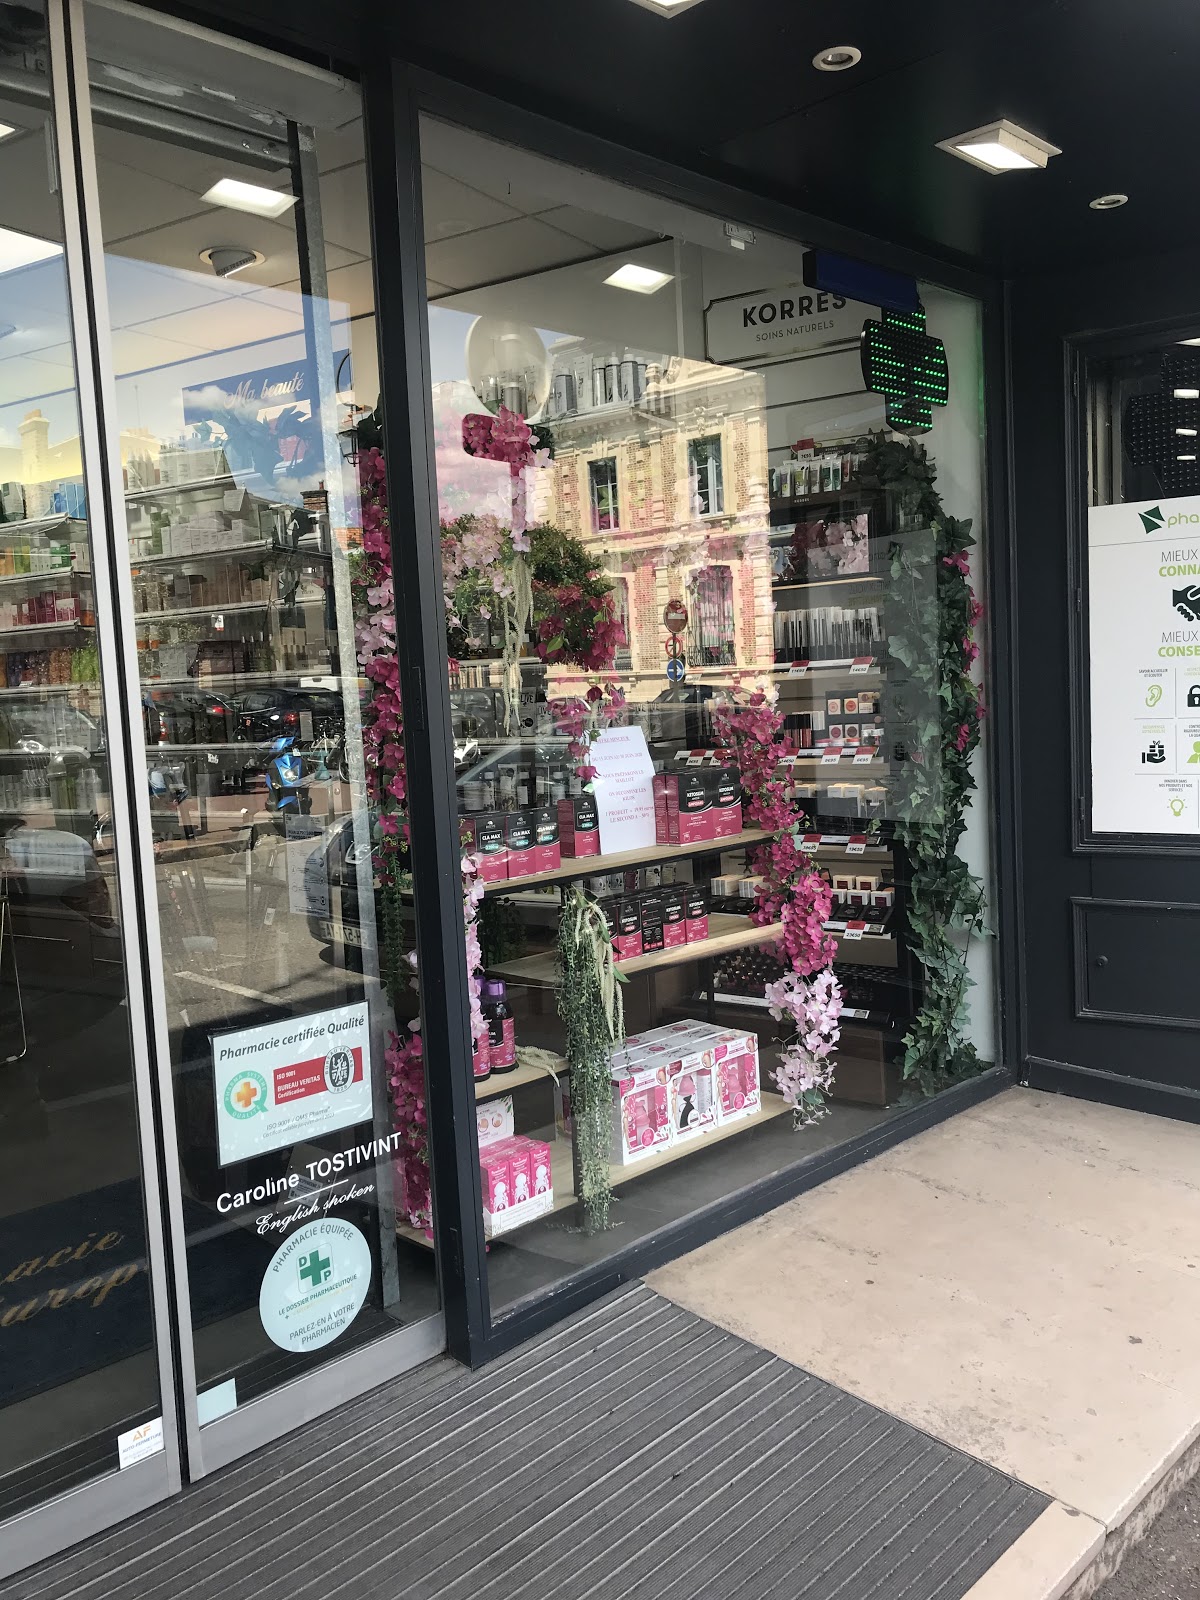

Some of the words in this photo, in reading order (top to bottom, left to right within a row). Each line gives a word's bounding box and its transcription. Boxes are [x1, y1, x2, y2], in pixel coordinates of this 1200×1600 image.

[743, 292, 847, 328] KORRES
[756, 330, 784, 342] SOINS
[786, 320, 834, 337] NATURELS
[224, 379, 256, 409] Ma
[260, 371, 305, 399] beauté
[1167, 512, 1200, 529] pha
[1161, 549, 1199, 562] MIEUX
[1161, 630, 1199, 643] MIEUX
[220, 1038, 280, 1061] Pharmacie
[282, 1026, 325, 1045] certifiée
[327, 1015, 365, 1034] Qualité
[277, 1071, 286, 1080] ISO
[277, 1081, 299, 1092] BUREAU
[299, 1075, 321, 1086] VERITAS
[277, 1087, 305, 1099] Certification
[266, 1122, 277, 1131] ISO
[216, 1172, 300, 1213] Caroline
[305, 1132, 402, 1181] TOSTIVINT
[255, 1197, 321, 1236] English
[323, 1182, 376, 1212] spoken
[272, 1226, 318, 1273] PHARMACIE
[320, 1222, 354, 1241] ÉQUIPÉE
[298, 1256, 308, 1267] D
[323, 1270, 332, 1281] P
[0, 1263, 149, 1327] urop
[286, 1297, 310, 1313] DOSSIER
[310, 1274, 357, 1301] PHARMACEUTIQUE
[289, 1316, 327, 1340] PARLEZ-EN
[333, 1302, 355, 1319] VOTRE
[301, 1317, 346, 1345] PHARMACIEN
[133, 1425, 151, 1442] AF
